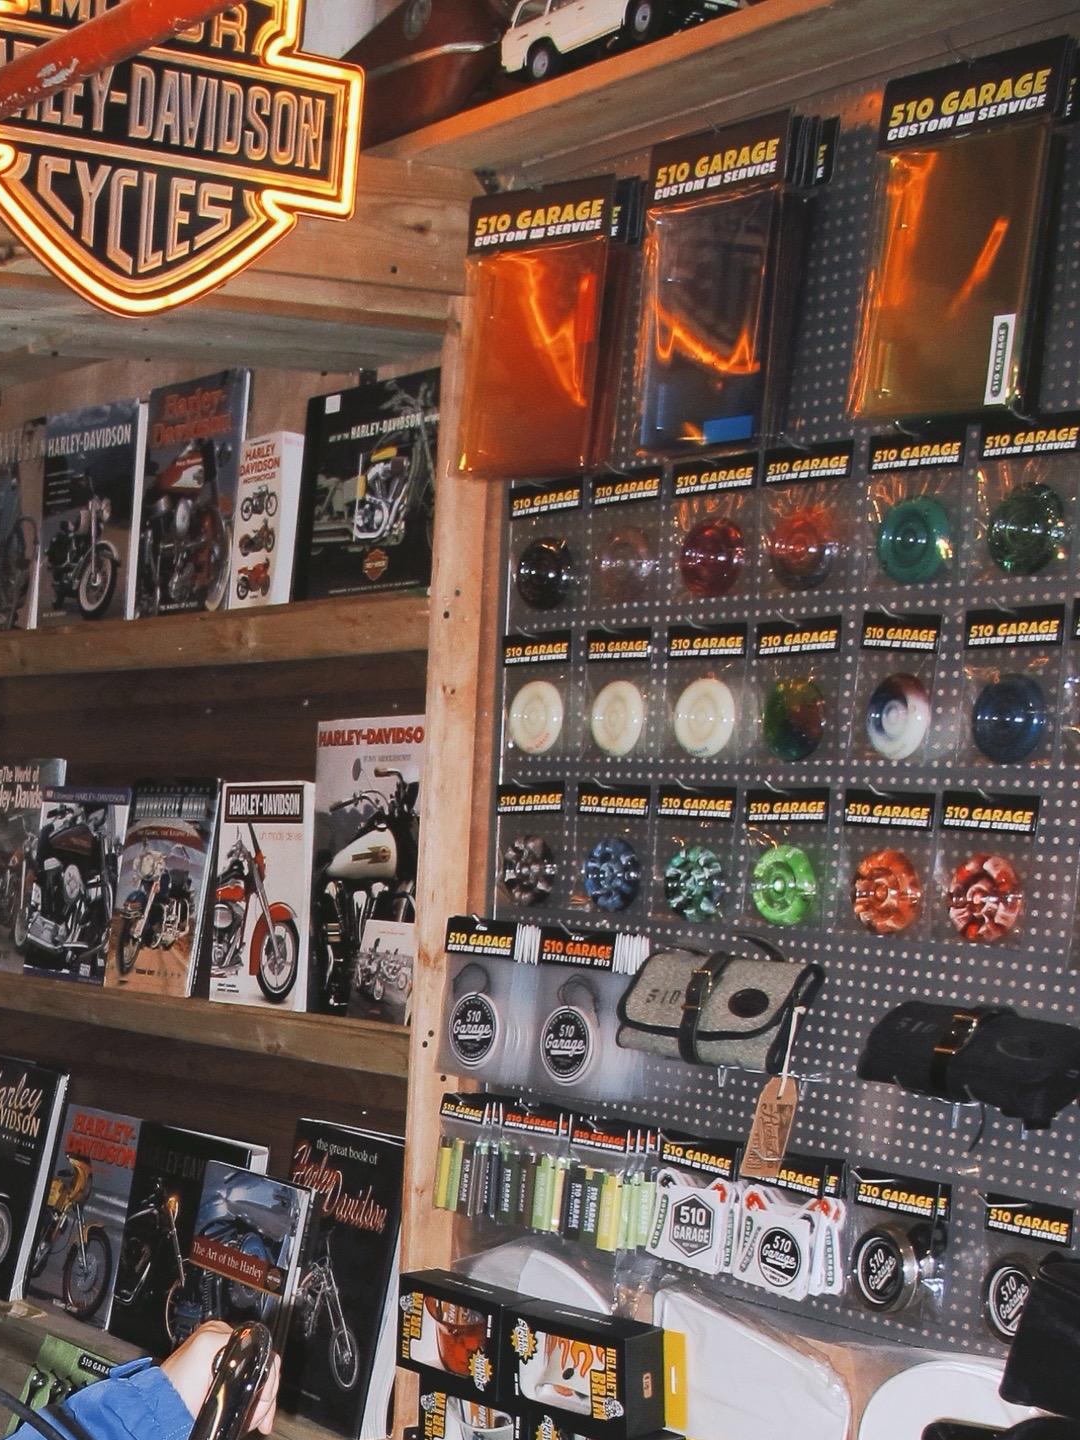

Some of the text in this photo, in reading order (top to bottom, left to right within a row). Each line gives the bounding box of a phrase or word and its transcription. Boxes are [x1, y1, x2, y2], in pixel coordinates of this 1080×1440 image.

[889, 68, 1052, 127] 510 GARAGE
[887, 93, 1047, 141] CUSTOM SERVICE
[655, 138, 780, 188] 510 GARAGE
[654, 161, 778, 200] CUSTOM SERVICE
[38, 155, 234, 274] CYCLES
[475, 199, 605, 236] 510 GARAGE
[474, 219, 602, 247] CUSTOM SERVICE
[351, 412, 422, 440] HARLEY-DAVIDSON
[48, 424, 132, 457] HARLEY-DAVIDSON
[985, 427, 1079, 448] 510 GARAGE
[245, 443, 276, 461] HARLEY
[874, 442, 961, 462] 510 GARAGE
[240, 457, 280, 476] DAVIDSON
[768, 456, 849, 475] 510 GARAGE
[595, 478, 660, 498] 510 GARAGE
[676, 467, 754, 488] 510 GARAGE
[513, 489, 580, 510] 510 GARAGE
[760, 630, 837, 648] 510 GARAGE
[865, 627, 936, 641] 510 GARAGE
[970, 620, 1059, 637] 510 GARAGE
[506, 642, 568, 657] 510 GARAGE
[590, 641, 648, 652] 510 GARAGE
[671, 637, 743, 649] 510 GARAGE
[500, 794, 562, 806] 510 GARAGE
[581, 796, 646, 808] 510 GARAGE
[662, 798, 732, 811] 510 GARAGE
[750, 801, 825, 813] 510 GARAGE
[848, 803, 930, 819] 510 GARAGE
[945, 806, 1034, 824] 510 GARAGE
[891, 818, 928, 827] SERVICE
[944, 819, 1031, 831] CUSTOM SERVICE
[449, 932, 512, 948] 510 GARAGE
[543, 940, 612, 959] 510 GARAGE
[483, 947, 510, 955] SERVICE
[542, 953, 591, 964] ESTABLISHED
[466, 1010, 481, 1022] 510
[453, 1019, 492, 1041] Garage
[558, 1025, 575, 1037] 510
[545, 1033, 585, 1056] Garage
[443, 1102, 455, 1111] 510
[456, 1104, 482, 1117] GARAGE
[506, 1114, 521, 1123] 510
[524, 1116, 557, 1128] GARAGE
[574, 1130, 589, 1139] 510
[591, 1132, 625, 1145] GARAGE
[64, 1133, 138, 1169] DAVIDSON
[316, 1138, 378, 1165] the great book of
[663, 1144, 732, 1169] 510 GARAGE
[663, 1154, 729, 1176] CUSTOM SERVICE
[858, 1195, 931, 1216] CUSTOM SERVICE
[859, 1184, 934, 1208] 510 GARAGE
[679, 1205, 706, 1226] 510
[990, 1208, 1068, 1235] 510 GARAGE
[673, 1225, 709, 1244] GARAGE
[988, 1220, 1067, 1242] CUSTOM SERVICE
[773, 1235, 791, 1251] 510
[193, 1242, 264, 1281] The Art of the Harley
[762, 1244, 796, 1269] Garage
[869, 1248, 884, 1274] 510
[869, 1255, 897, 1290] Garage
[1000, 1275, 1016, 1298] 510
[410, 1292, 424, 1339] BRIM
[402, 1312, 411, 1359] HELMET
[81, 1356, 93, 1369] 510
[606, 1347, 616, 1400] HELMET
[590, 1370, 608, 1421] BRIM
[432, 1392, 446, 1438] BRIM
